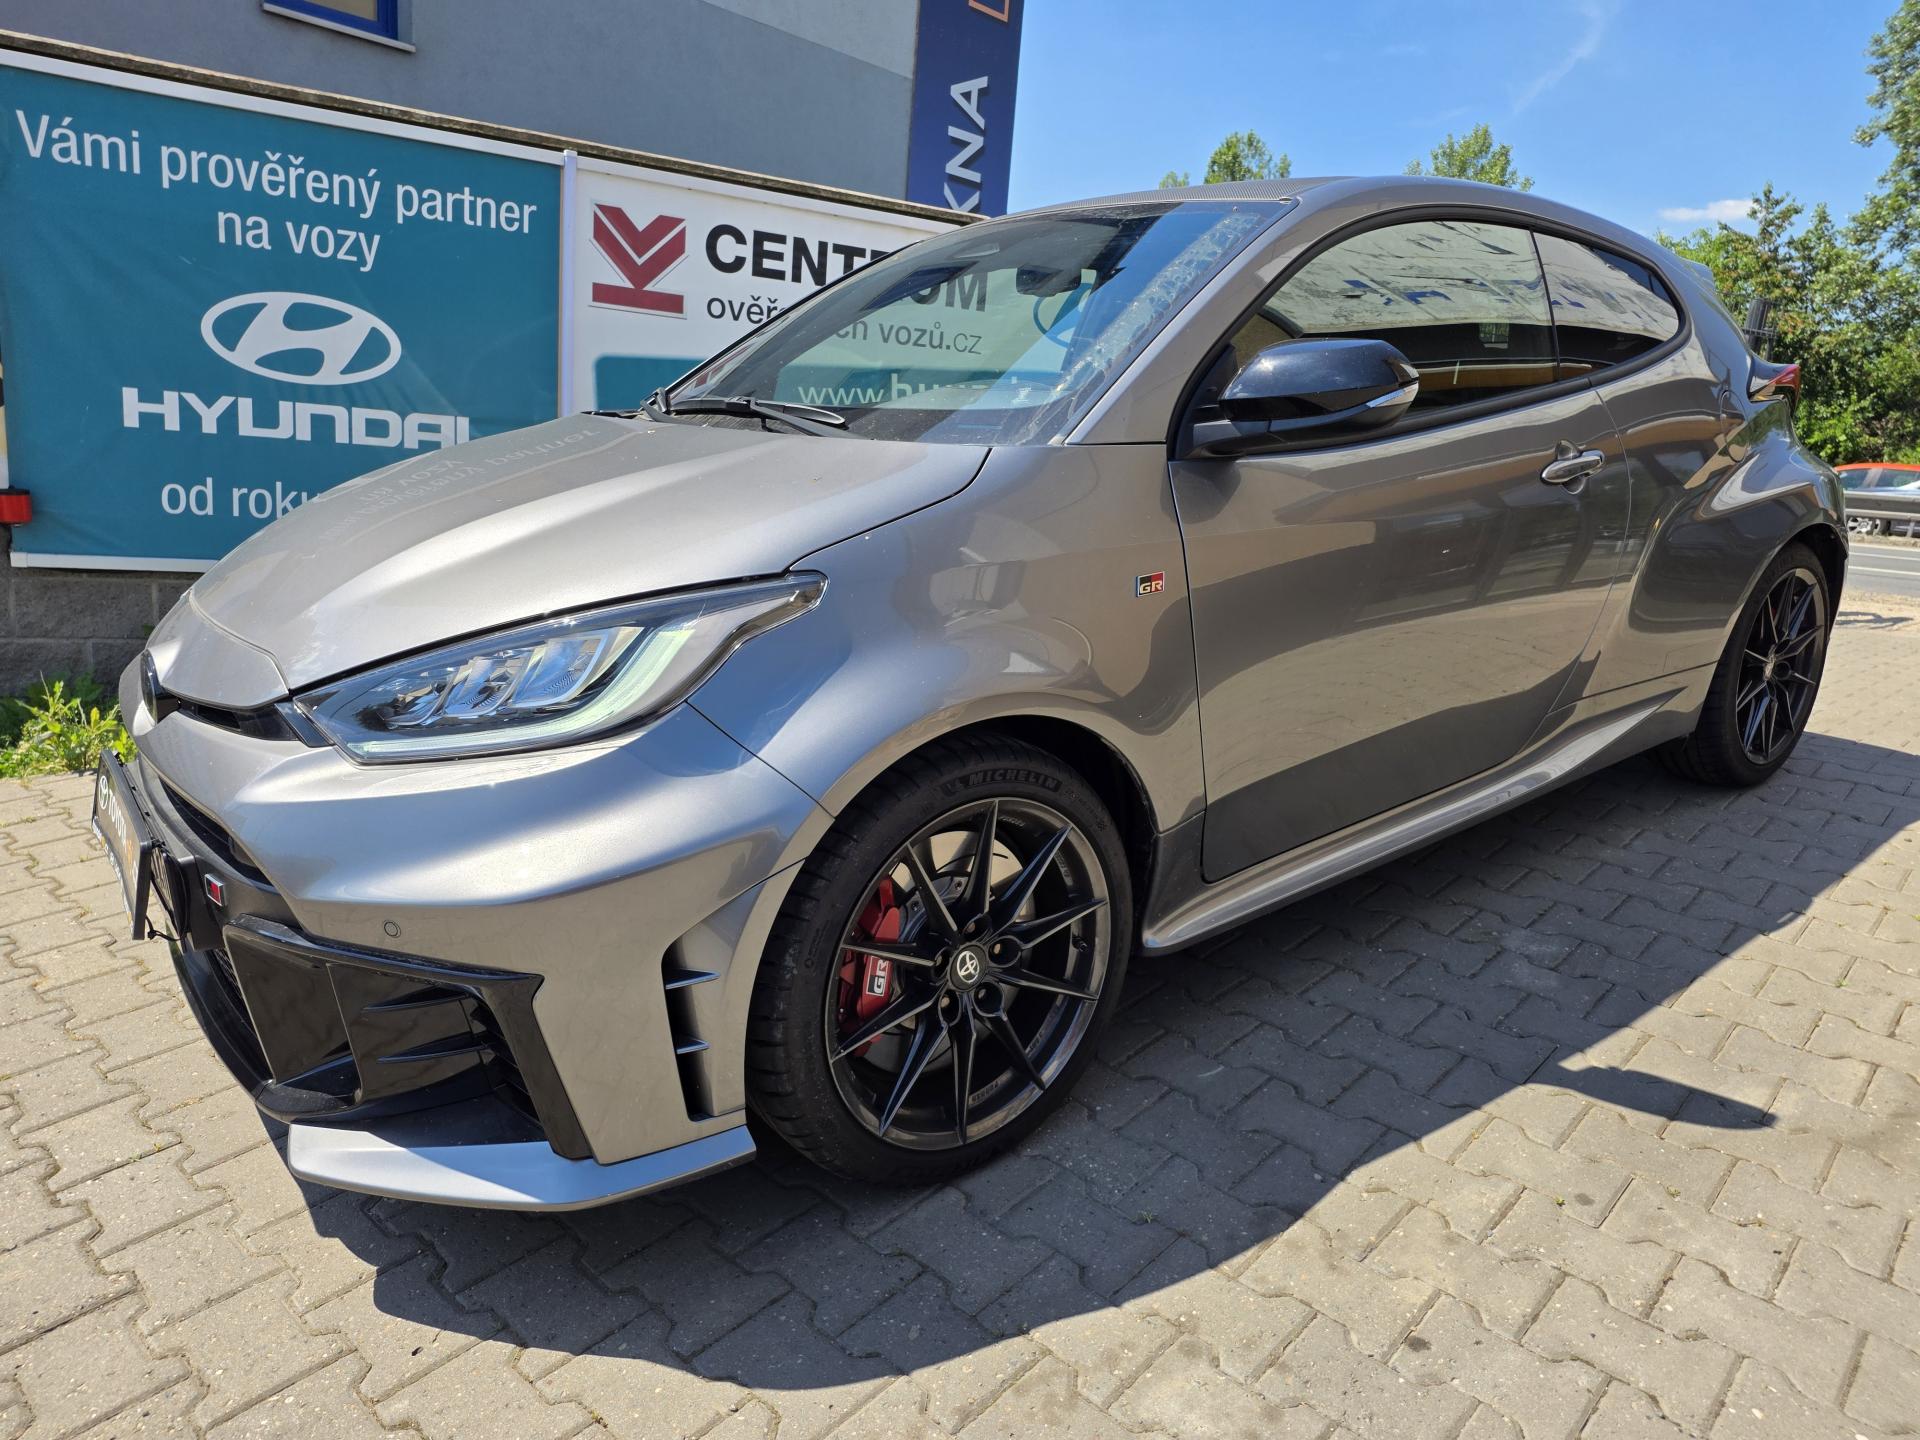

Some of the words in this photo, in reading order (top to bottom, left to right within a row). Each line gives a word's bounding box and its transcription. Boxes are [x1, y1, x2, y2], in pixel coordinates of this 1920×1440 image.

[16, 108, 141, 175] Vámi
[161, 145, 381, 219] prověřený
[396, 183, 537, 234] partner
[218, 210, 271, 250] na
[286, 222, 381, 273] vozy
[705, 223, 988, 312] CENTM
[878, 320, 983, 355] vozů.cz
[122, 387, 470, 449] HYUNDAI
[161, 476, 214, 516] od
[967, 768, 1058, 789] MICHELIN
[873, 957, 889, 994] GR
